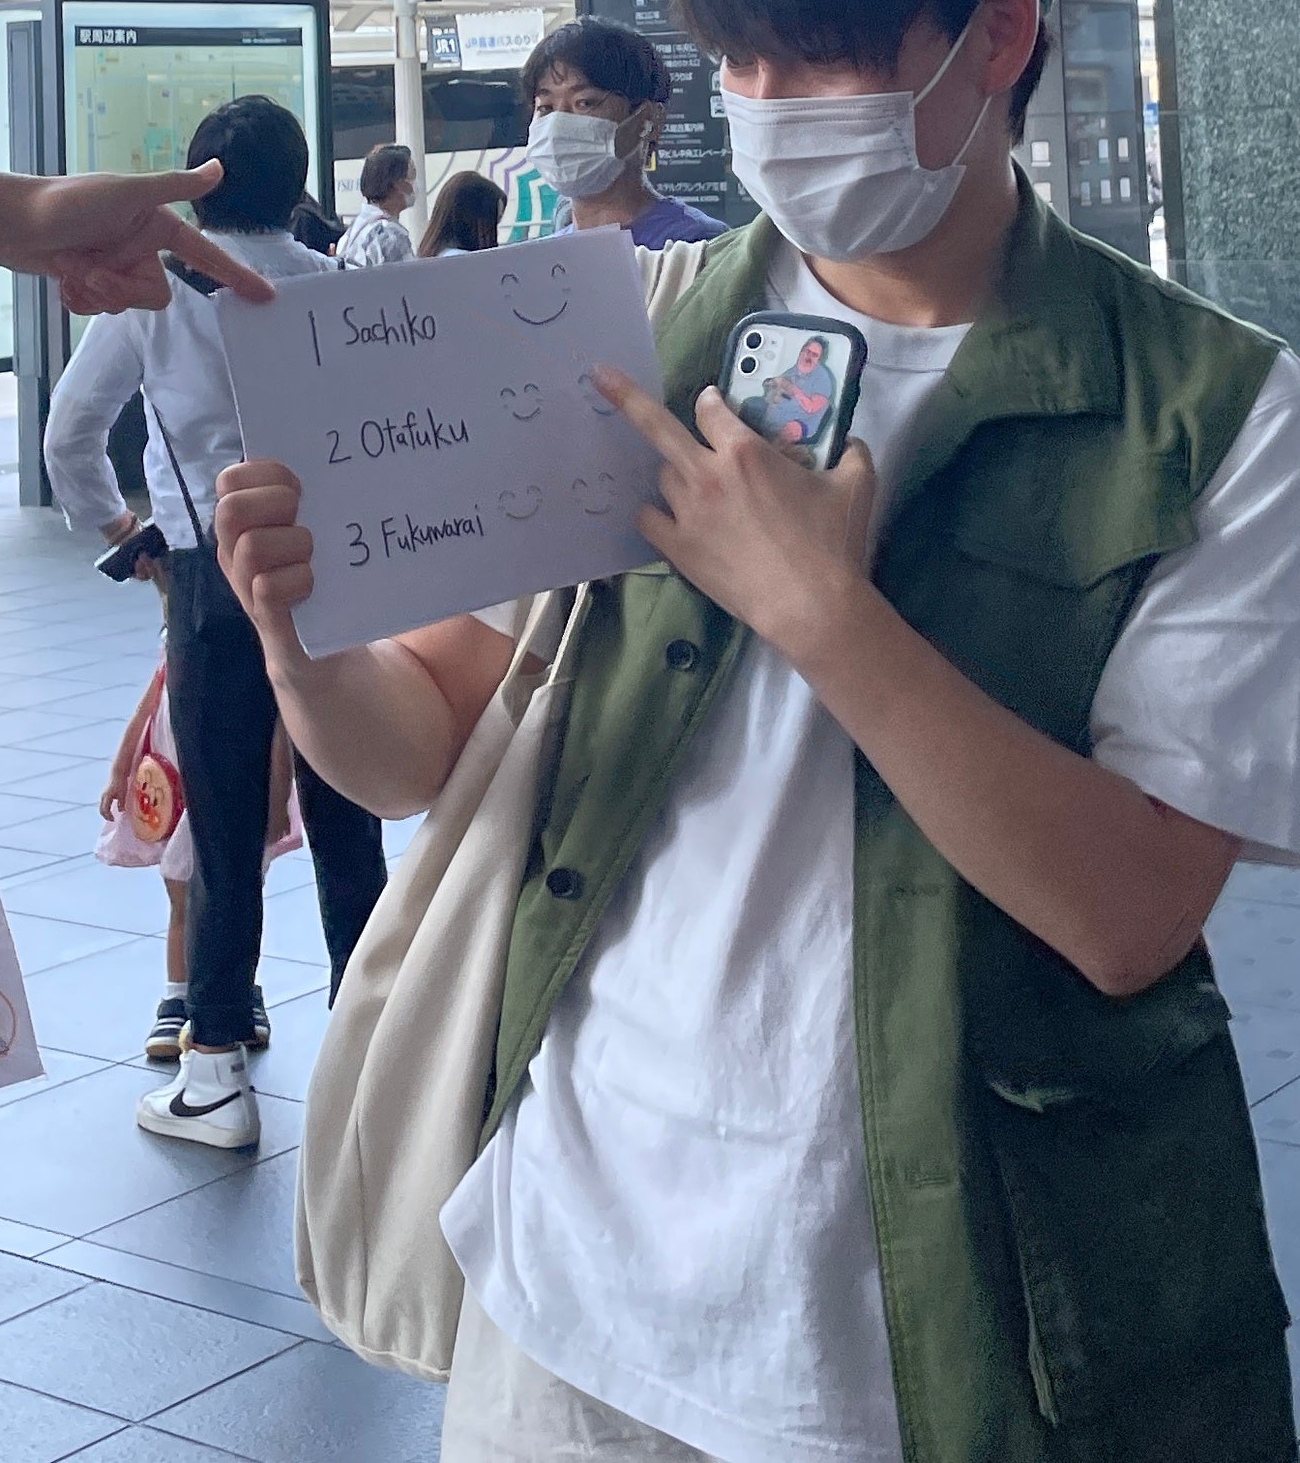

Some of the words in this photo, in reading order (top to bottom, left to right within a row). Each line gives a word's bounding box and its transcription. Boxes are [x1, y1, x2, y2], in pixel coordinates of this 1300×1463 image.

[435, 38, 457, 54] JR1
[326, 430, 352, 464] 2
[360, 407, 470, 459] Otafuku
[345, 522, 370, 567] 3
